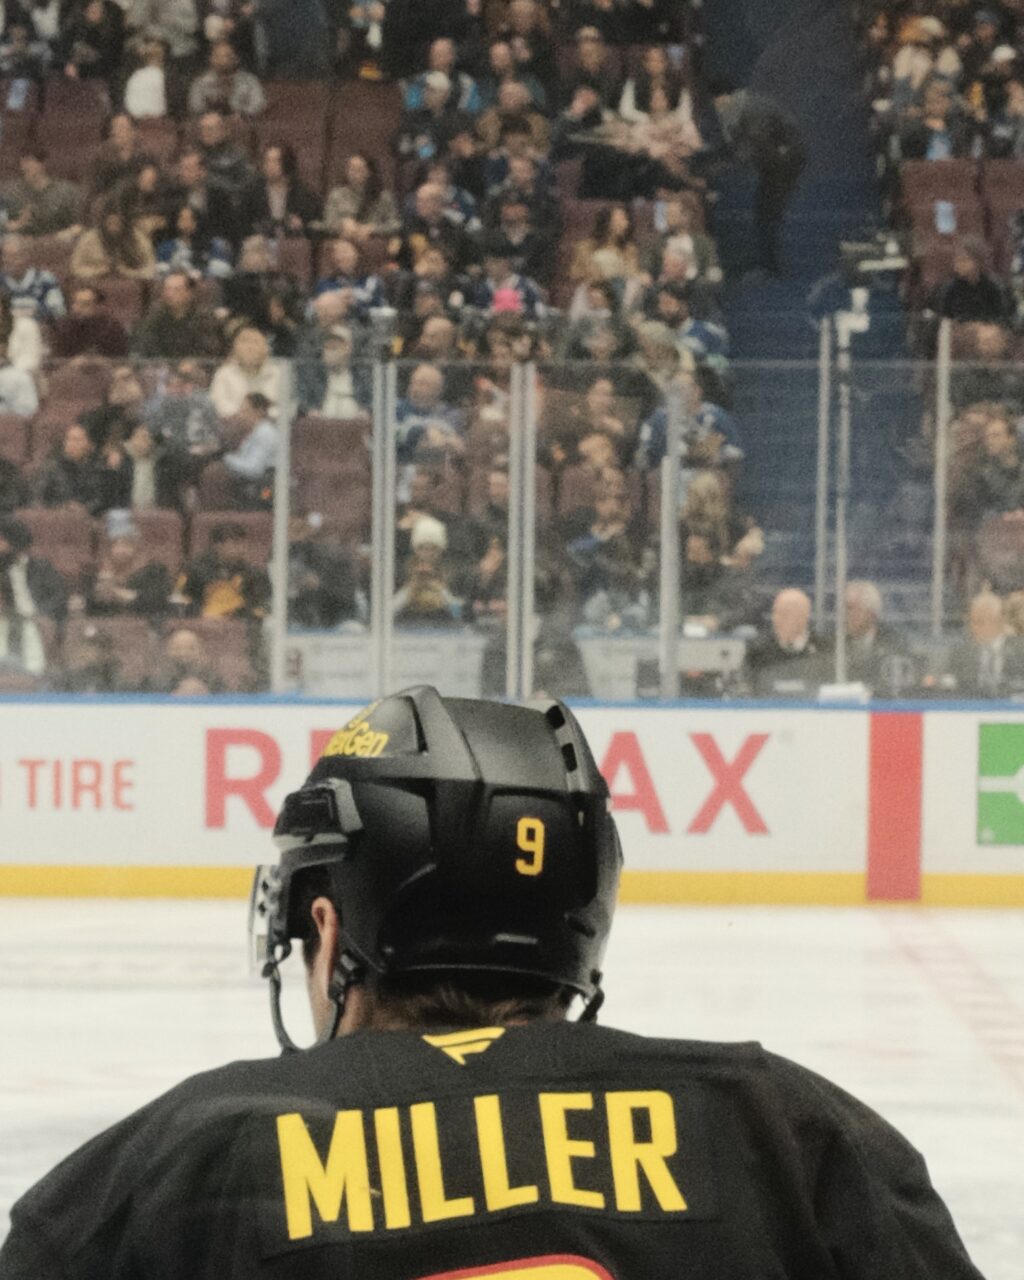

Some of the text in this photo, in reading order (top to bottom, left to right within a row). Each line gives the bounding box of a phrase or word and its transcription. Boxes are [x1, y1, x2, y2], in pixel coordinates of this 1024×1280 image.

[18, 758, 137, 811] TIRE
[516, 816, 545, 876] 9
[276, 1090, 688, 1240] MILLER
